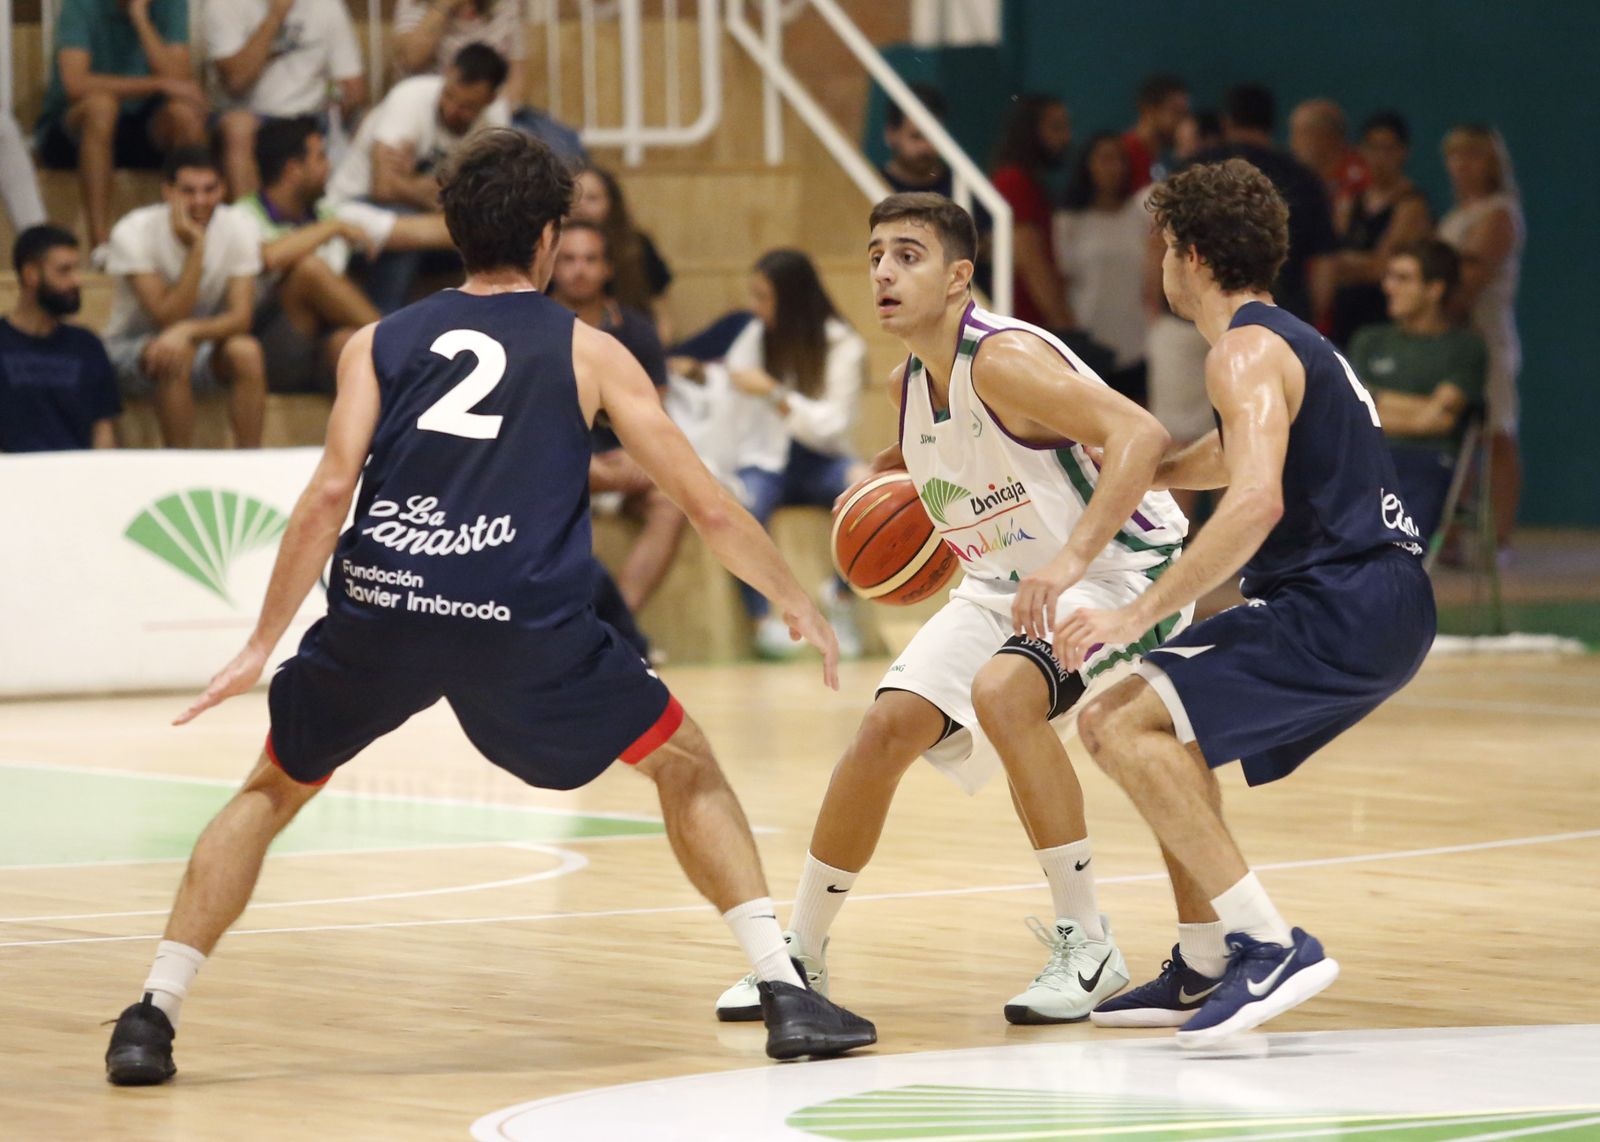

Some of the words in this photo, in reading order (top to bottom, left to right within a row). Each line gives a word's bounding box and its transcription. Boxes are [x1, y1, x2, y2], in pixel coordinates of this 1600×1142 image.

[417, 329, 507, 439] 2
[398, 495, 446, 526] La
[969, 475, 1027, 516] Unicaja
[342, 559, 424, 588] Fundación
[344, 578, 402, 609] Javier
[406, 590, 512, 622] Imbroda
